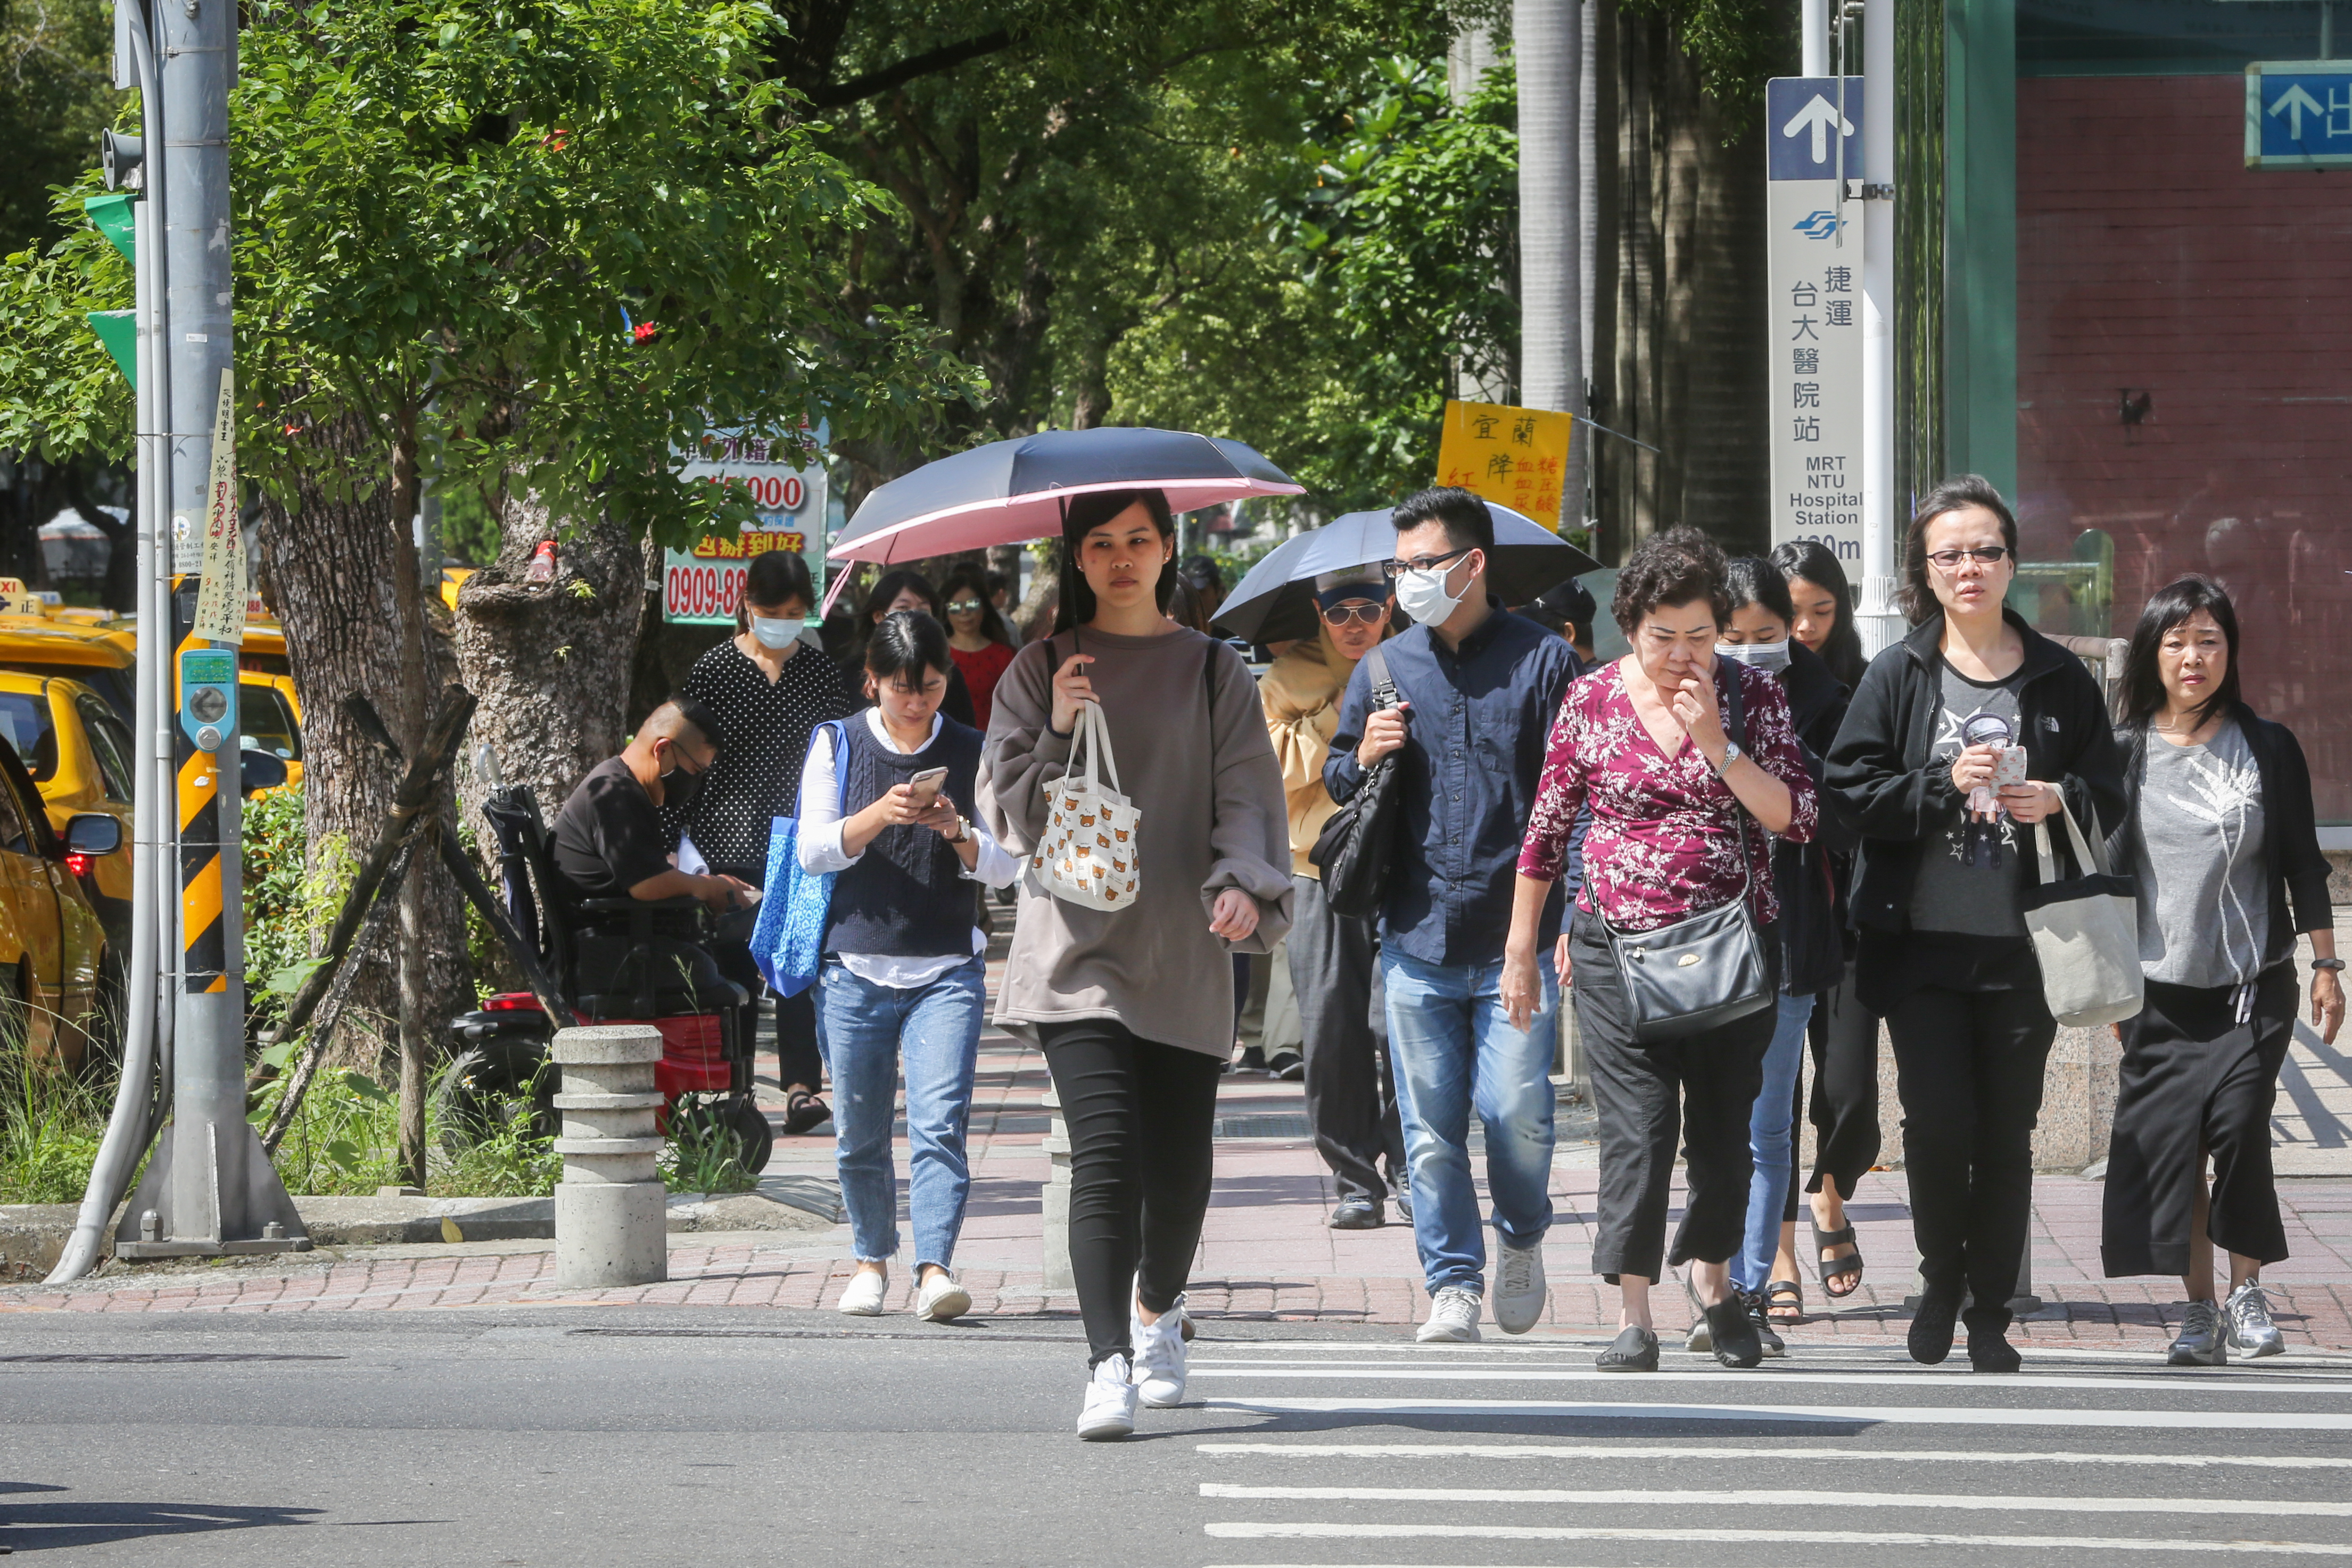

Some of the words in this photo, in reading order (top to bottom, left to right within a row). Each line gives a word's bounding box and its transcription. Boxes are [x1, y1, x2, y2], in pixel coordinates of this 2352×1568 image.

[1825, 266, 1852, 326] 捷運
[1791, 280, 1820, 442] 台大醫院站
[1472, 414, 1537, 447] 宜蘭
[1488, 453, 1514, 484] 降
[1516, 456, 1560, 474] 血糖
[1806, 456, 1846, 471] MRT
[1808, 474, 1844, 489] NTU
[1512, 493, 1558, 517] 尿酸
[1790, 492, 1863, 510] Hospital
[1795, 510, 1858, 525] Station
[1796, 534, 1861, 559] 0m
